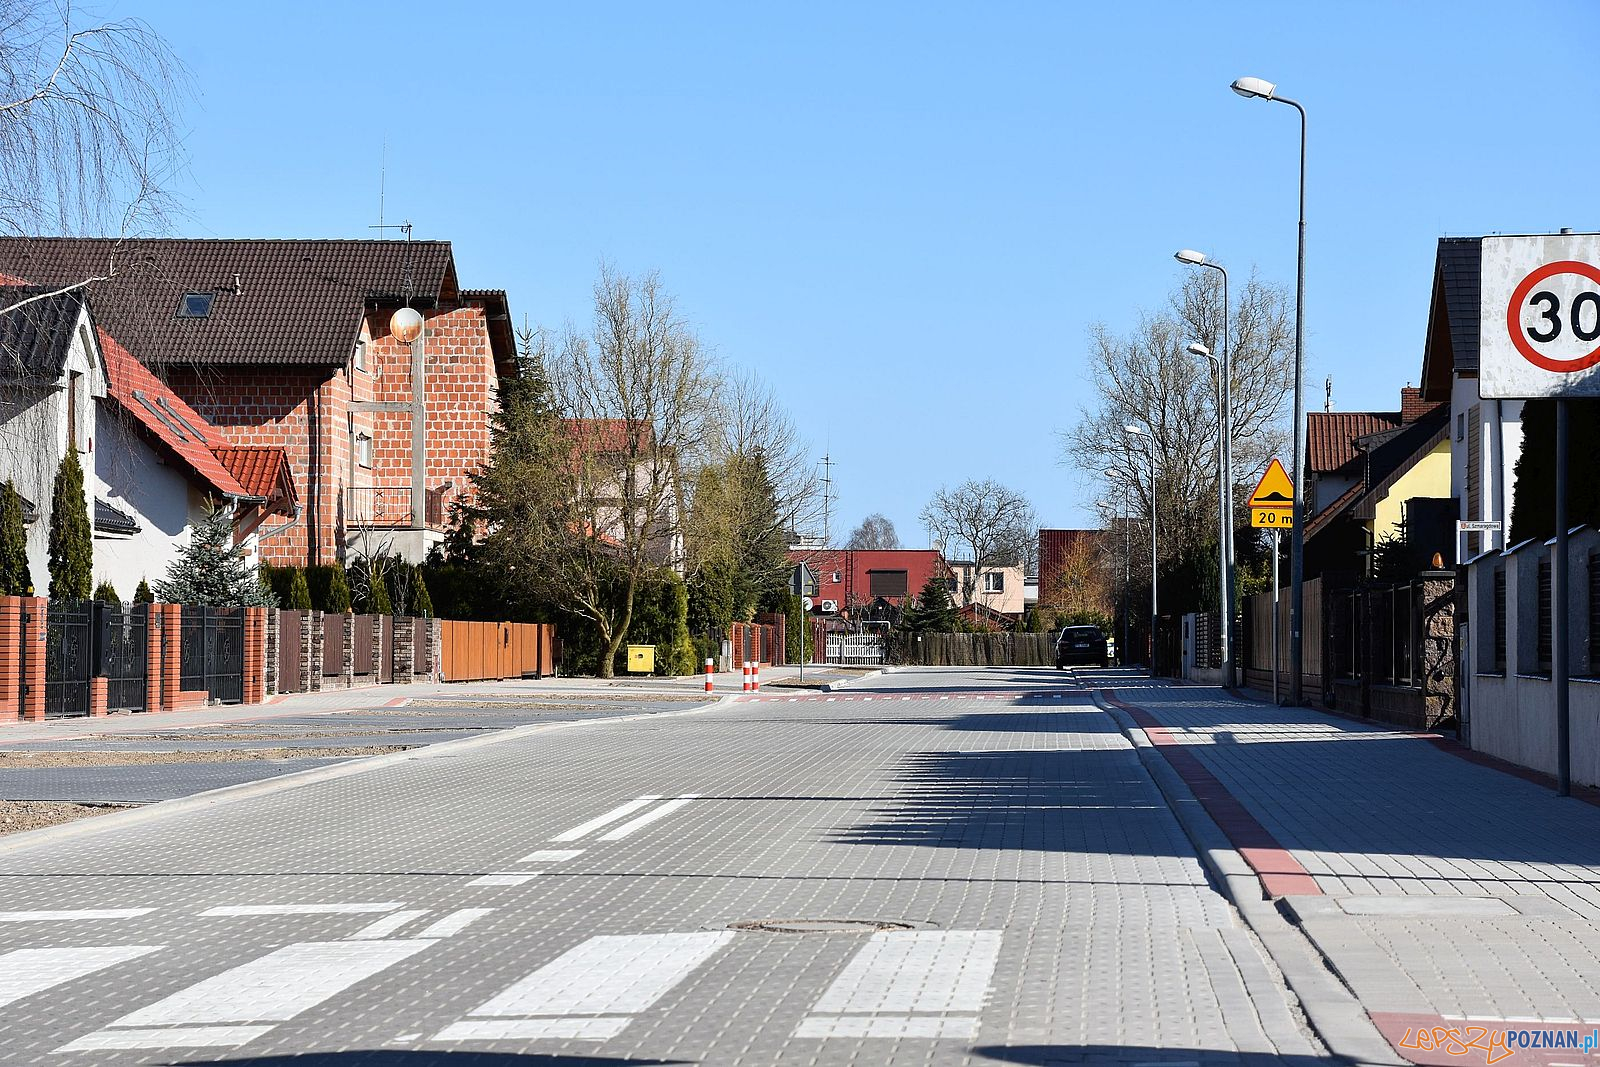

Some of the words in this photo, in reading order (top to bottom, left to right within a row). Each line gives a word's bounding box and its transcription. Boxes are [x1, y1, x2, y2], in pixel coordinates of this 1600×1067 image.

[1526, 291, 1600, 343] 30
[1259, 512, 1276, 524] 20
[1281, 516, 1292, 524] m
